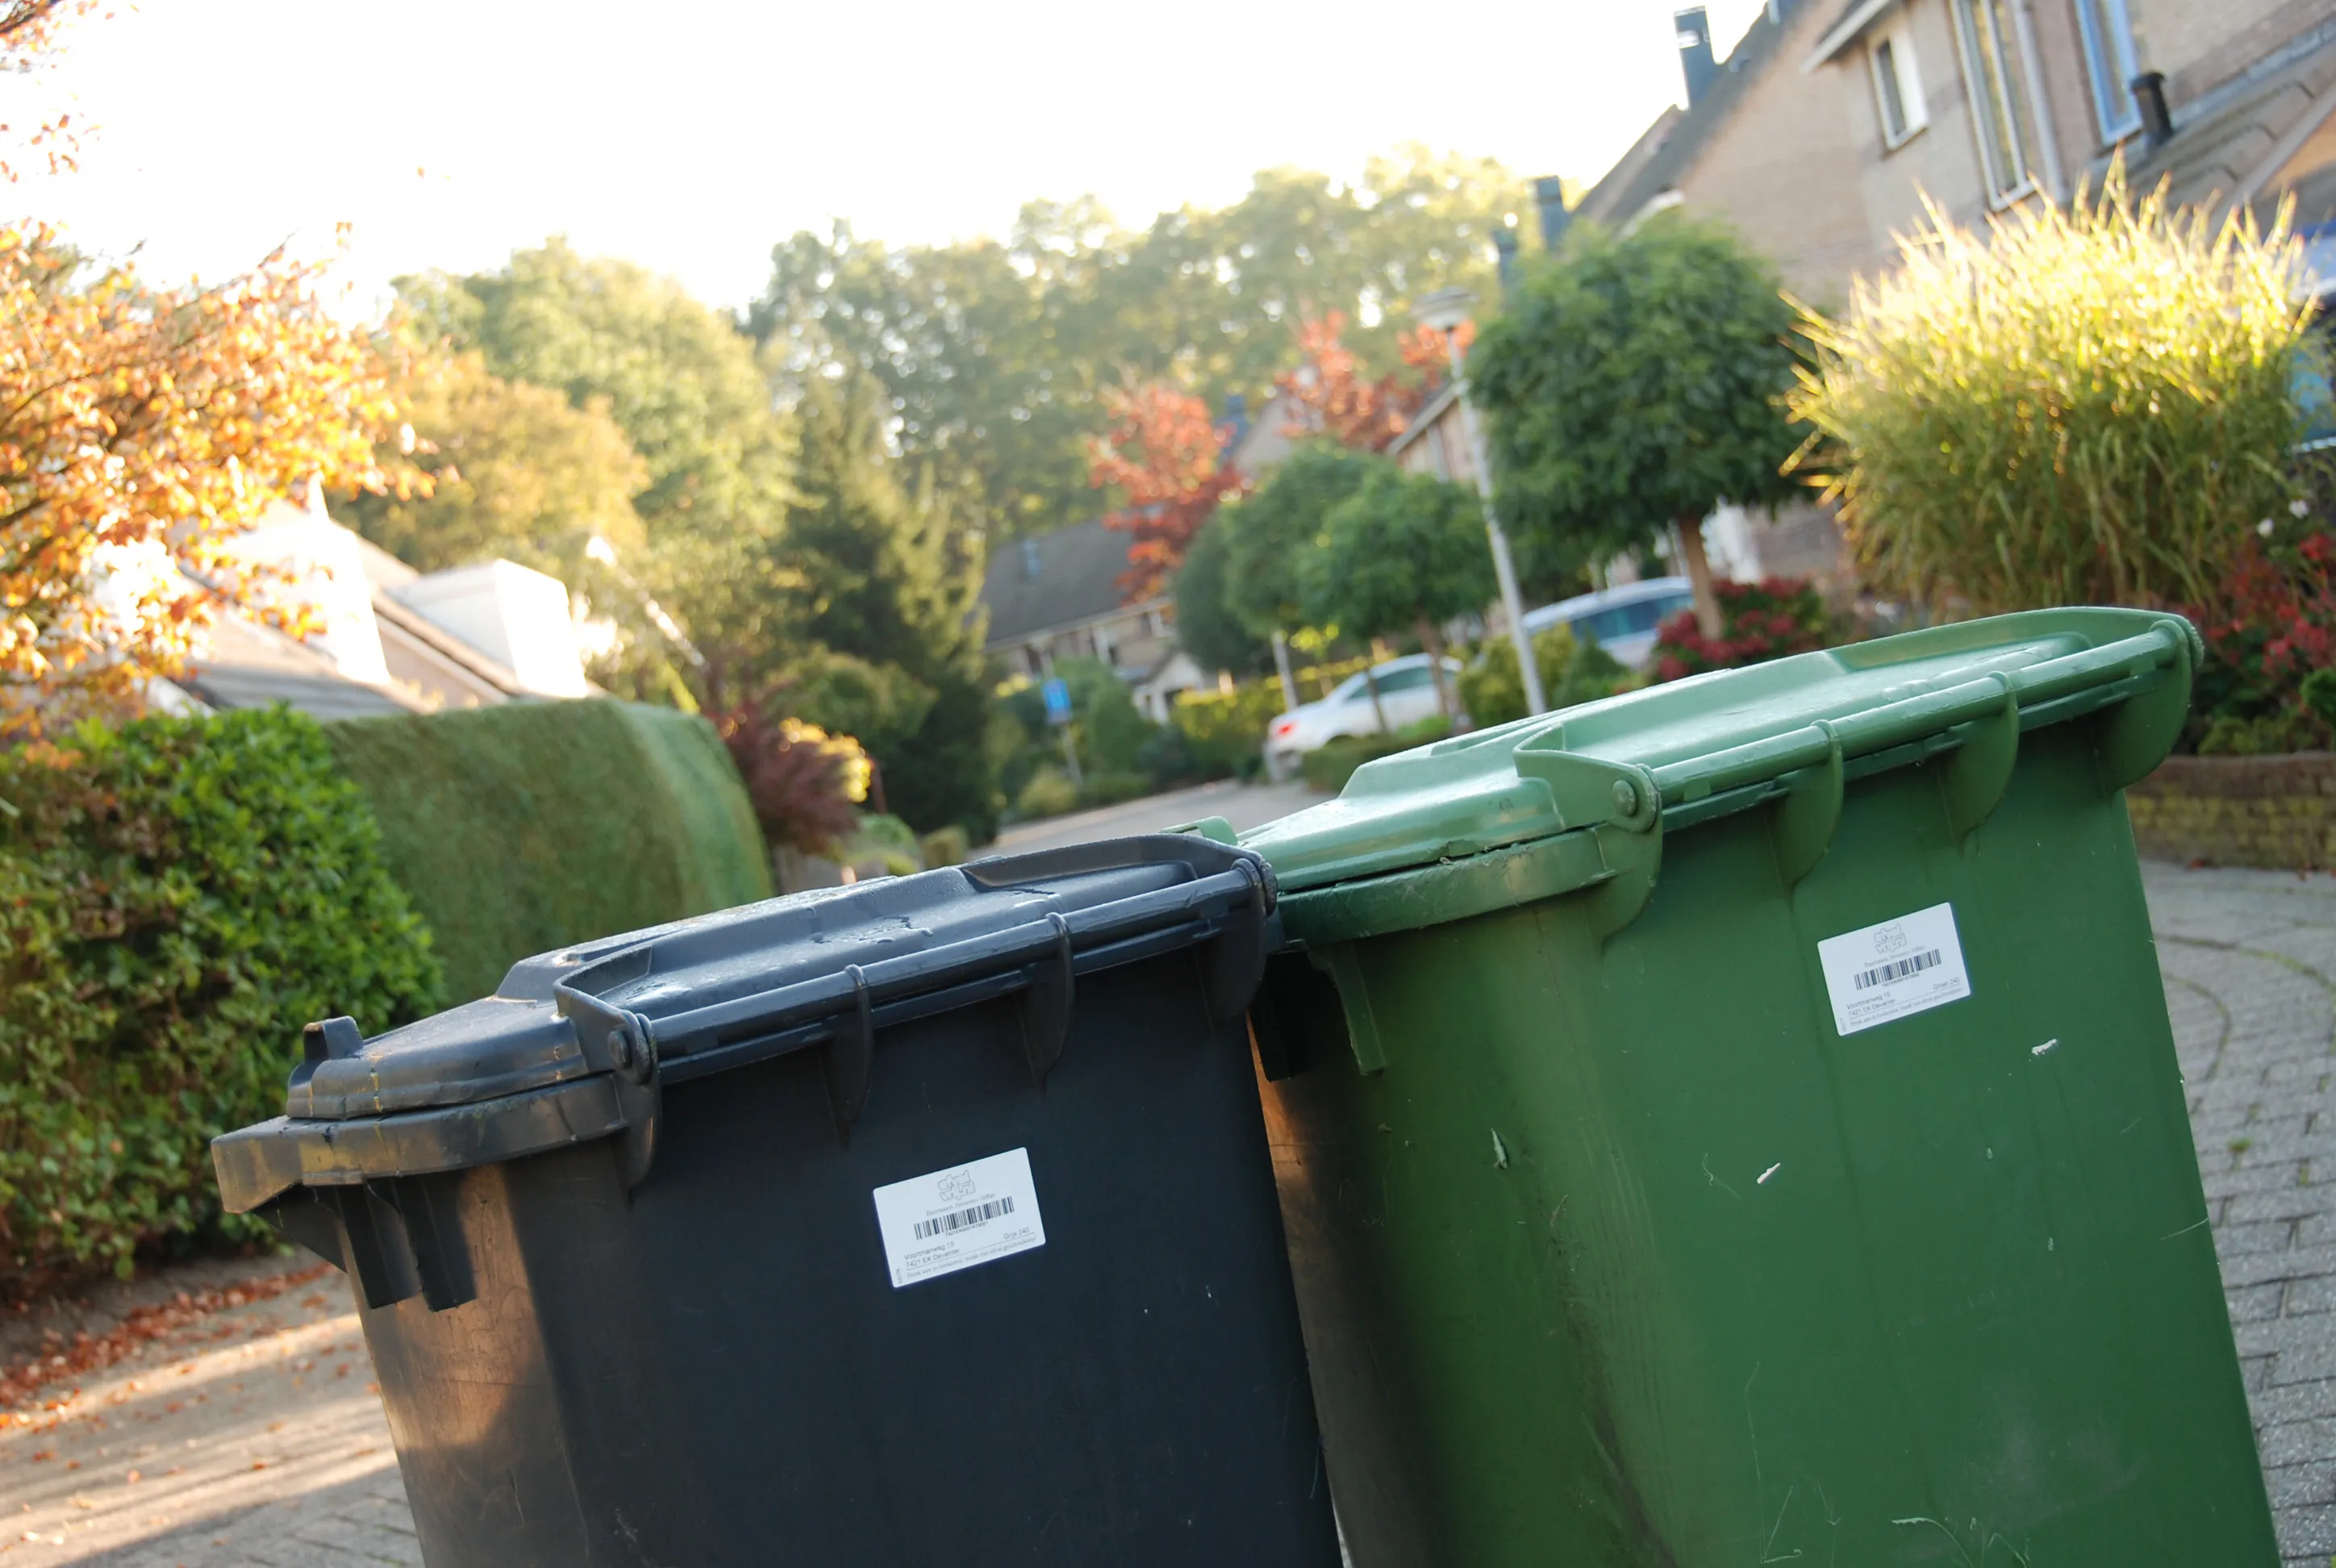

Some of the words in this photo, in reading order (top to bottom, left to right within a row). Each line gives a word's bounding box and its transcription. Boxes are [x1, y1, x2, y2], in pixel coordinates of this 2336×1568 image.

[1848, 1008, 1861, 1016] 7421
[1017, 1226, 1029, 1235] 240
[906, 1259, 921, 1268] 7421
[922, 1255, 932, 1263] EK
[933, 1248, 960, 1260] Deventer
